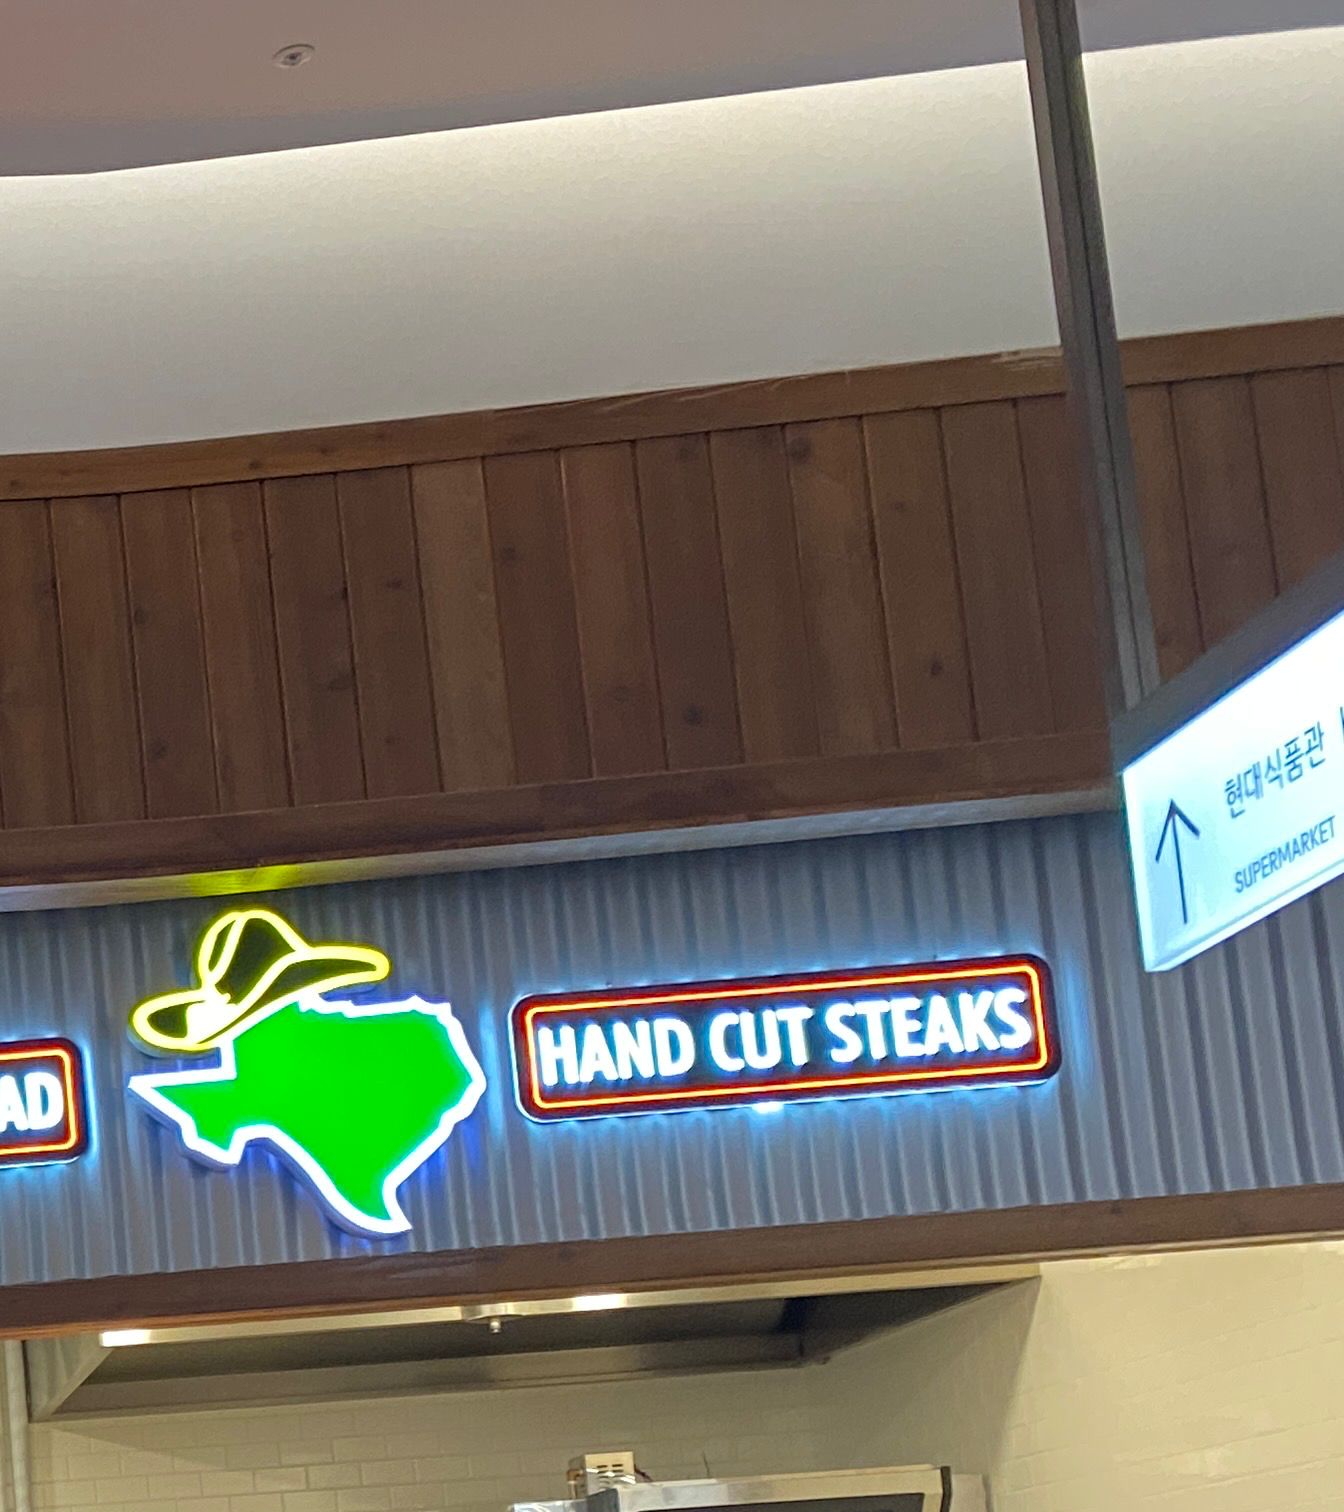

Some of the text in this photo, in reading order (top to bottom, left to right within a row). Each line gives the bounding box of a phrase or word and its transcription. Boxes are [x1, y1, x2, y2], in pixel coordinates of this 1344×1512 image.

[1225, 721, 1326, 819] 현대식품관
[1234, 815, 1335, 893] SUPERMARKET
[538, 987, 1031, 1085] HAND CUT STEAKS
